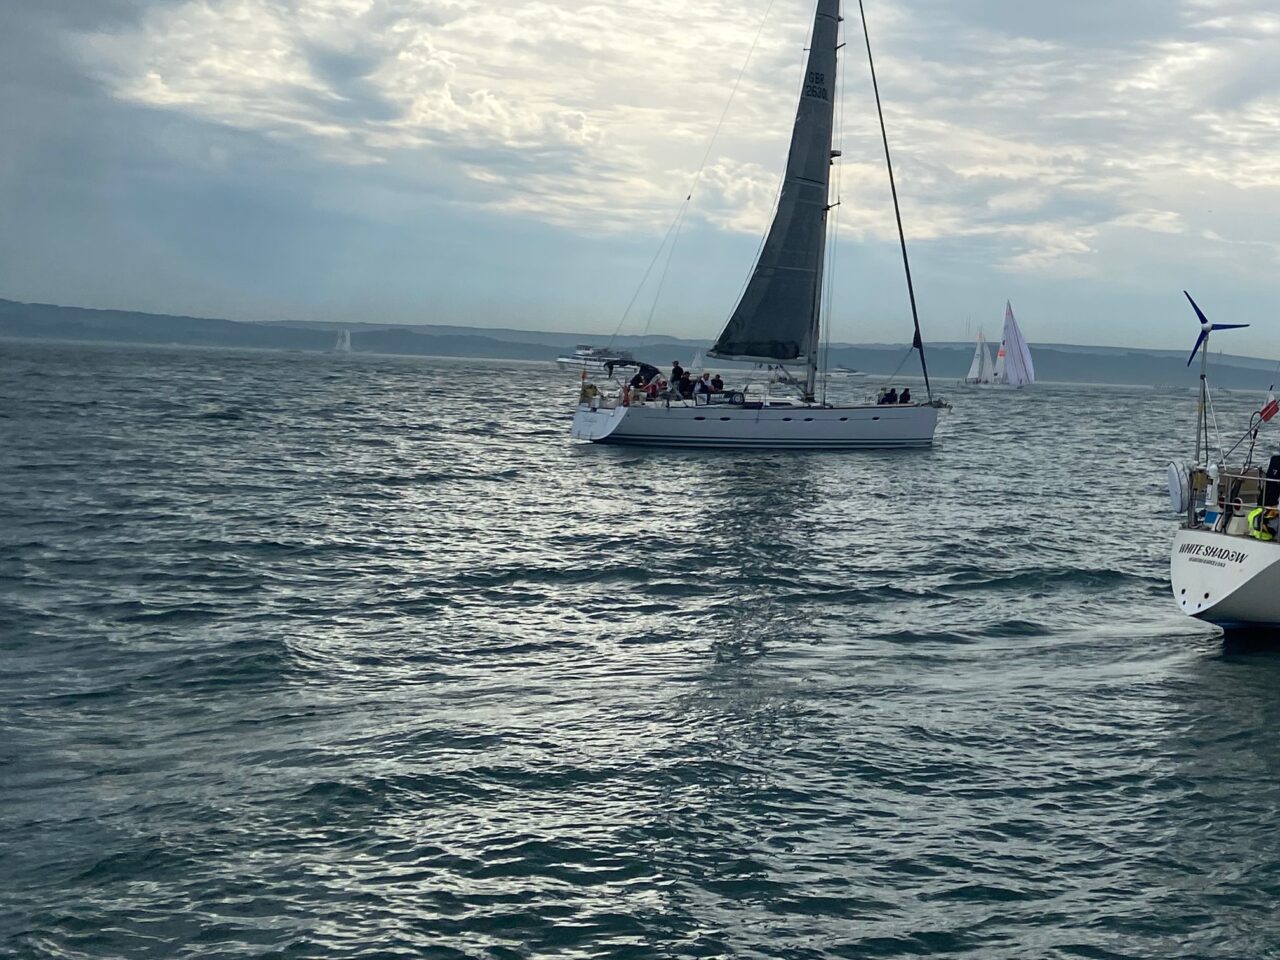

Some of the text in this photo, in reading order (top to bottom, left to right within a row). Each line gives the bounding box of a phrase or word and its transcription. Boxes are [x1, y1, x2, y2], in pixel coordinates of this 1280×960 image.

[808, 71, 825, 85] GBR
[1179, 543, 1205, 556] WHITE
[1202, 545, 1248, 563] SHADOW
